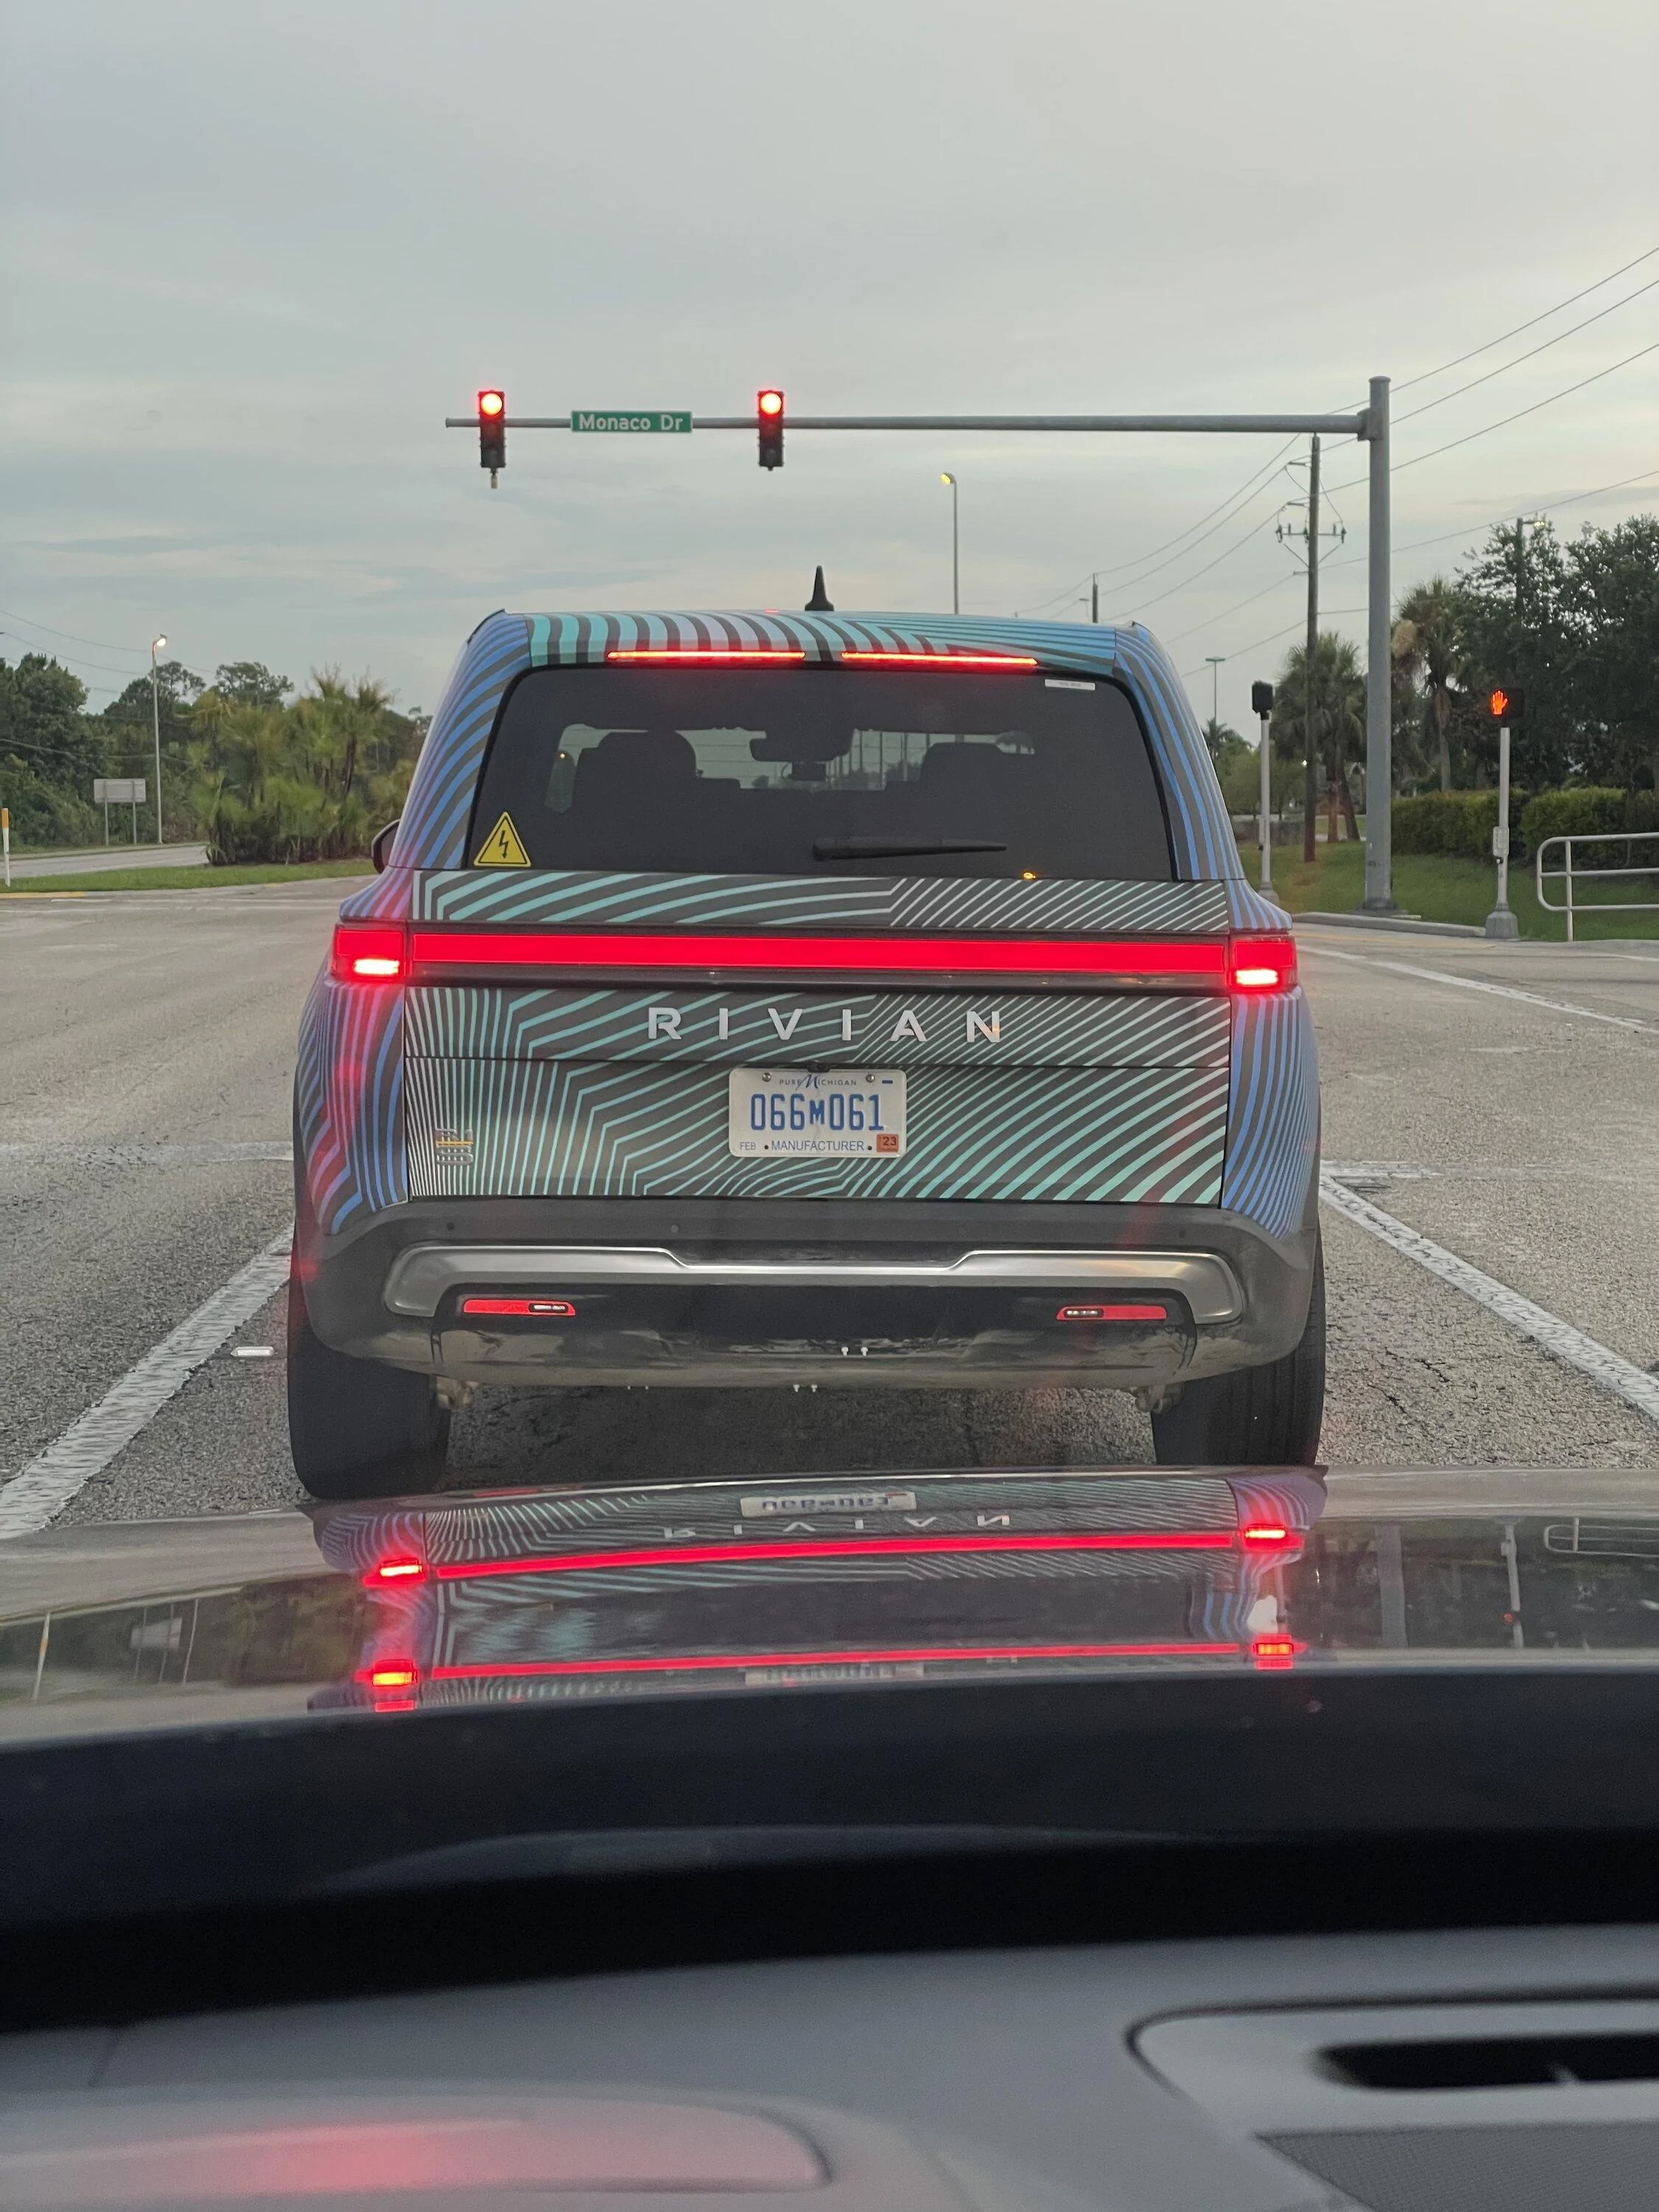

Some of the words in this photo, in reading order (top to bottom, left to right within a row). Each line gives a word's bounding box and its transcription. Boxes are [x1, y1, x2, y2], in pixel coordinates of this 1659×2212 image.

[579, 413, 651, 431] Monaco
[660, 414, 684, 431] Dr
[648, 1006, 1001, 1043] RIVIAN
[750, 1093, 885, 1131] 066M061
[739, 1140, 757, 1151] FEB
[771, 1140, 865, 1152] MANUFACTURER
